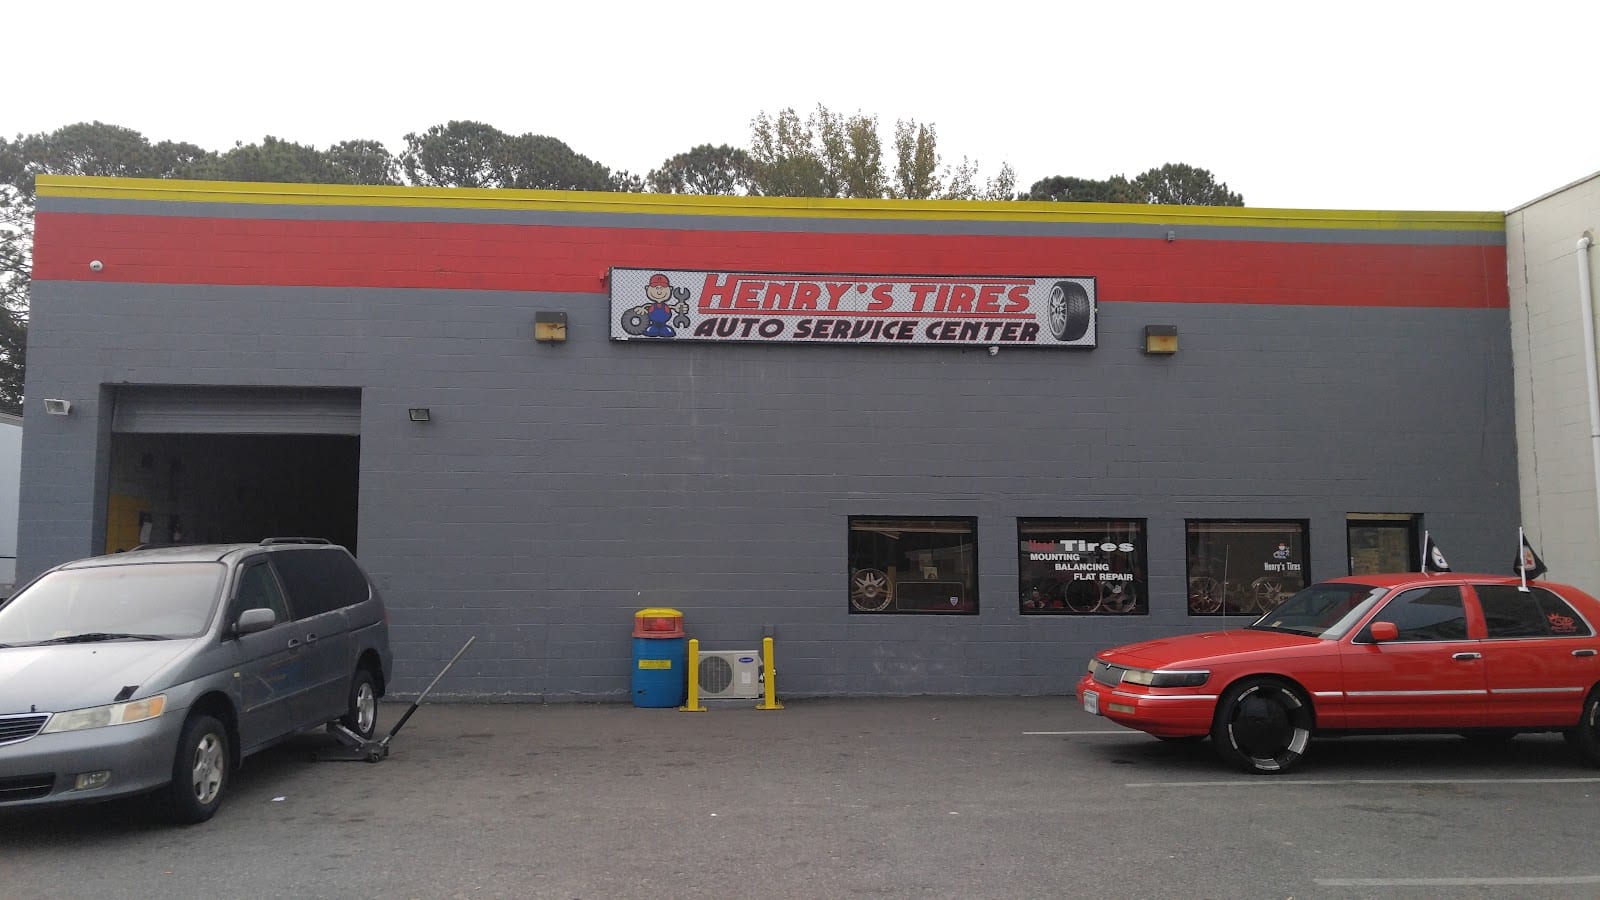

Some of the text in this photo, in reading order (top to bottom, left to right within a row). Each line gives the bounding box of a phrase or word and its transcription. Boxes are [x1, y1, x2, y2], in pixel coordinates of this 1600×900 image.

[698, 273, 1030, 312] HENRY'S TIRES
[693, 317, 1041, 342] AUTO SERVICE CENTER
[1059, 539, 1135, 552] Tires
[1030, 553, 1080, 561] MOUNTING
[1055, 563, 1110, 571] BALANCING
[1264, 562, 1301, 572] Henry's Tires
[1073, 573, 1134, 581] FLAT REPAIR
